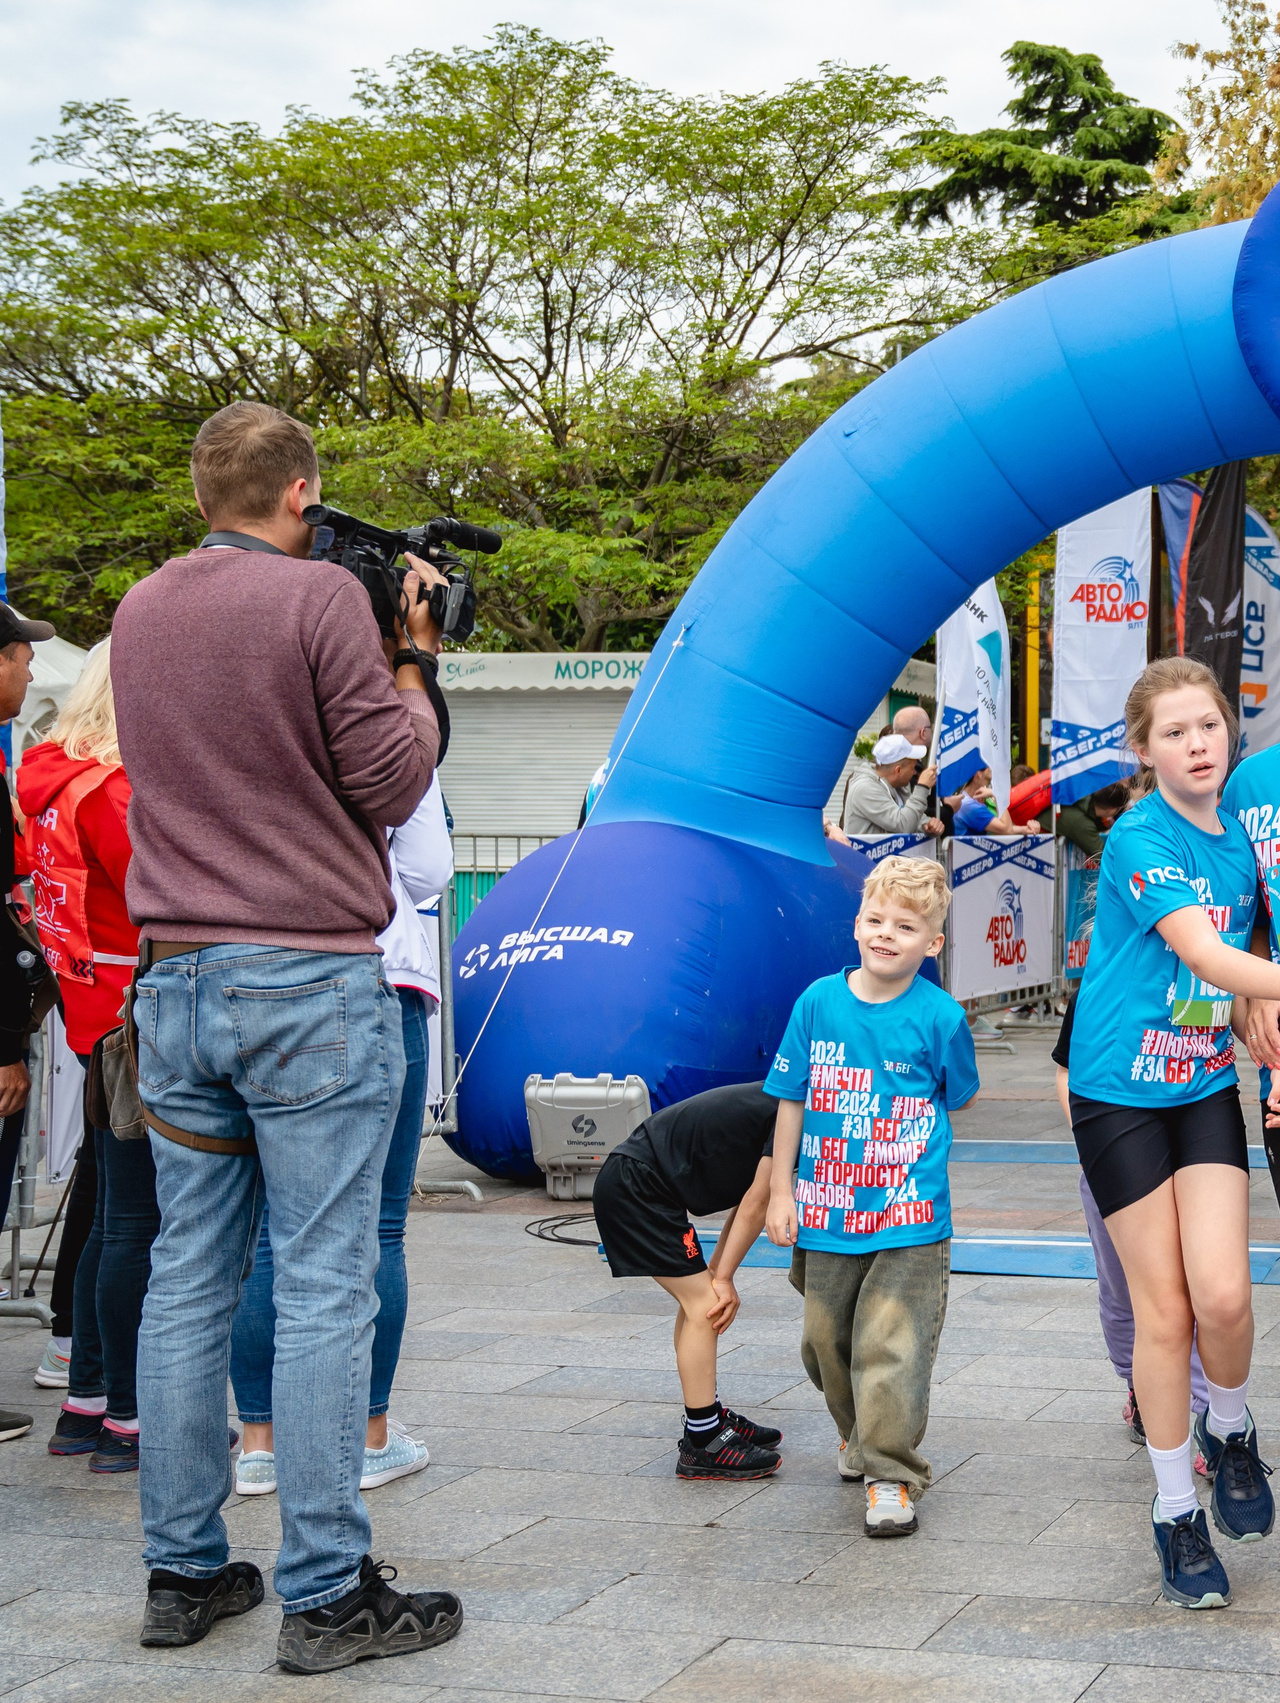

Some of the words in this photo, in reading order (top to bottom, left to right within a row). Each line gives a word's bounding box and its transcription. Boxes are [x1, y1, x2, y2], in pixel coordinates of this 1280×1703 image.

[1069, 583, 1123, 603] АВТО
[1086, 601, 1148, 622] РАДИО
[499, 926, 634, 949] ВЫСШАЯ
[986, 915, 1013, 943] АВТО
[489, 944, 563, 970] ЛИГА
[993, 938, 1027, 968] РАДИО
[1141, 1029, 1218, 1060] #ЛЮБОВЬ
[811, 1065, 874, 1092] #МЕЧТА
[863, 1140, 928, 1164] #МОМЕ
[814, 1160, 909, 1188] #ГОРДОСТЬ
